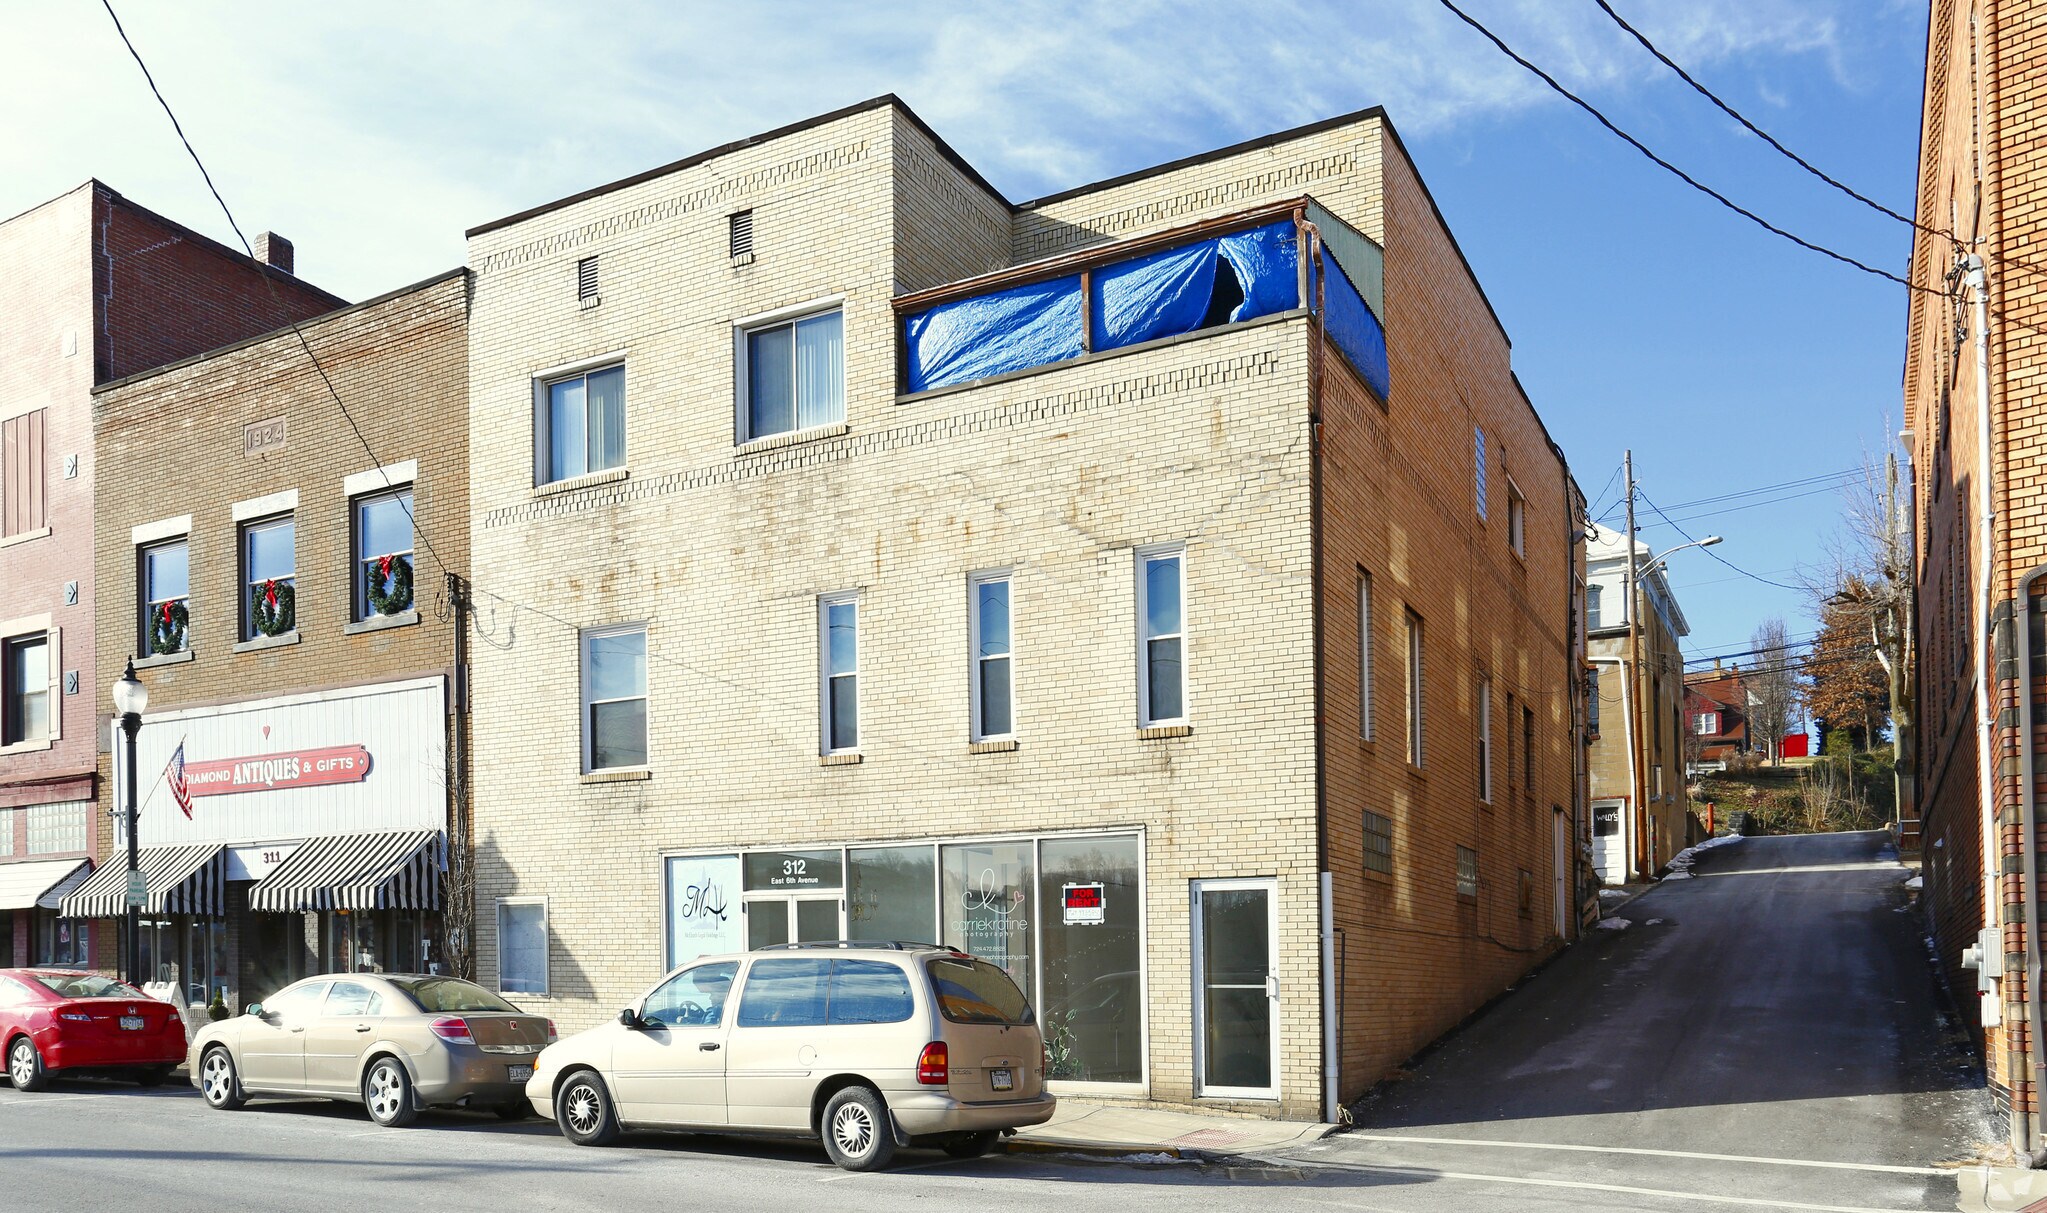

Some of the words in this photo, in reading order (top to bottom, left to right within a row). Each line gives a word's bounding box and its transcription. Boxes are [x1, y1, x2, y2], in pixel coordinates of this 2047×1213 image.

[248, 424, 284, 449] 1924
[185, 770, 231, 785] DIAMOND
[232, 756, 300, 787] ANTIQUES
[303, 761, 312, 773] &
[316, 757, 354, 770] GIFTS
[263, 850, 282, 864] 311
[782, 859, 807, 875] 312
[771, 877, 785, 885] East
[785, 876, 796, 884] 6th
[797, 876, 819, 884] Avenue
[1072, 889, 1094, 898] FOR
[1067, 898, 1100, 907] RENT
